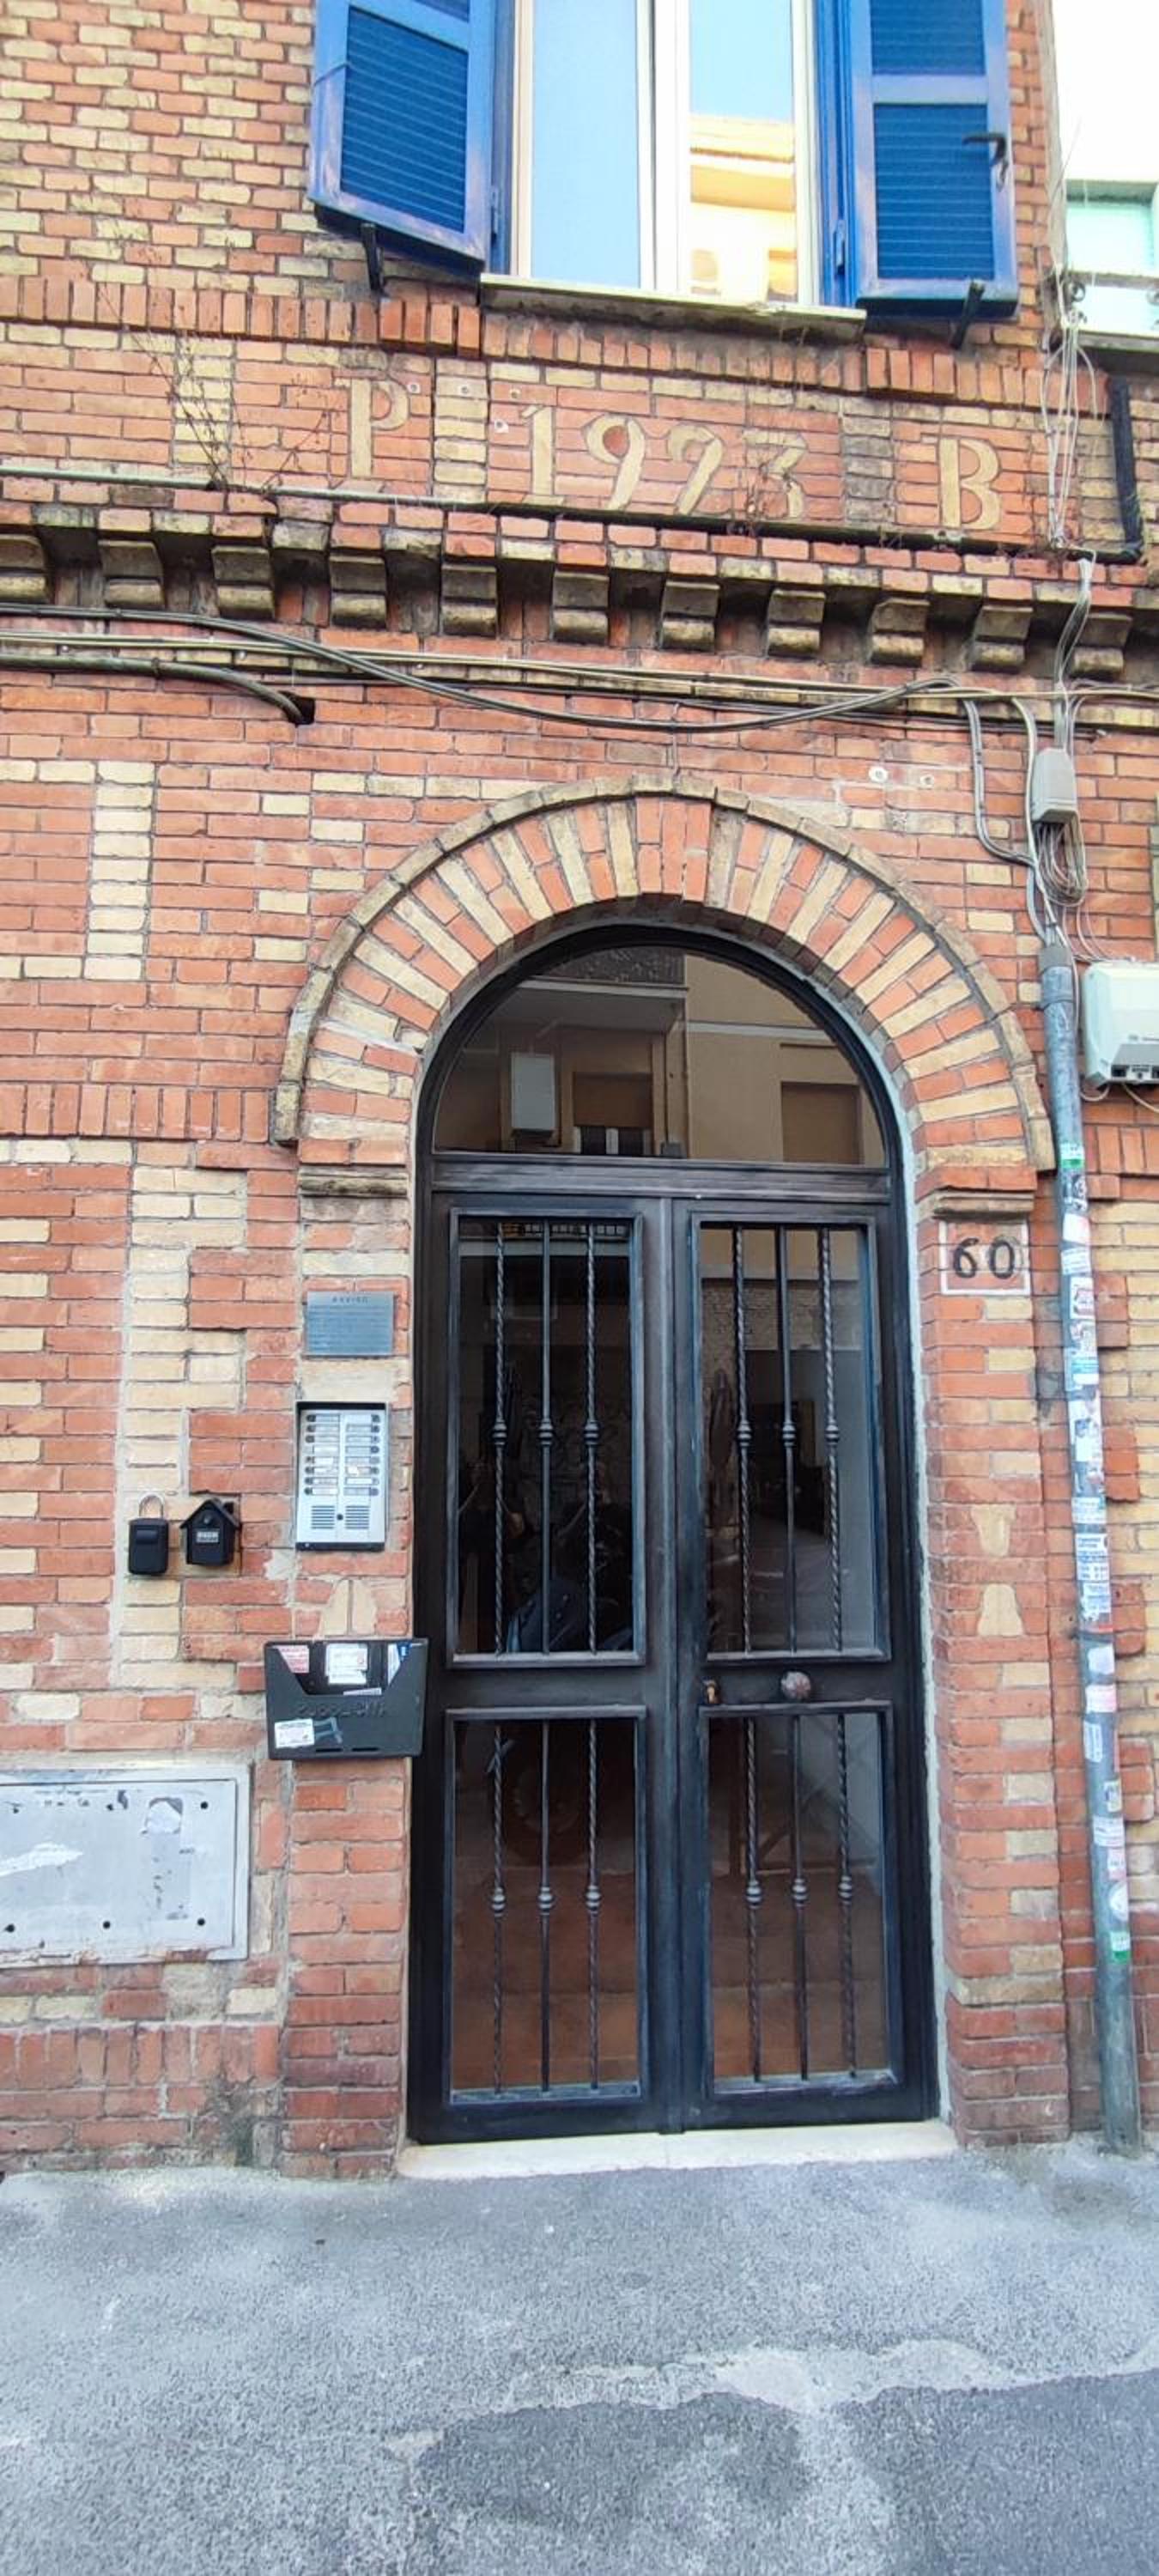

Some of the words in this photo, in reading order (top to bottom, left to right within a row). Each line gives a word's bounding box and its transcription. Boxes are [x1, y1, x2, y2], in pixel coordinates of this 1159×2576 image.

[335, 379, 410, 481] P
[927, 437, 1003, 531] B
[953, 1237, 1016, 1279] 60
